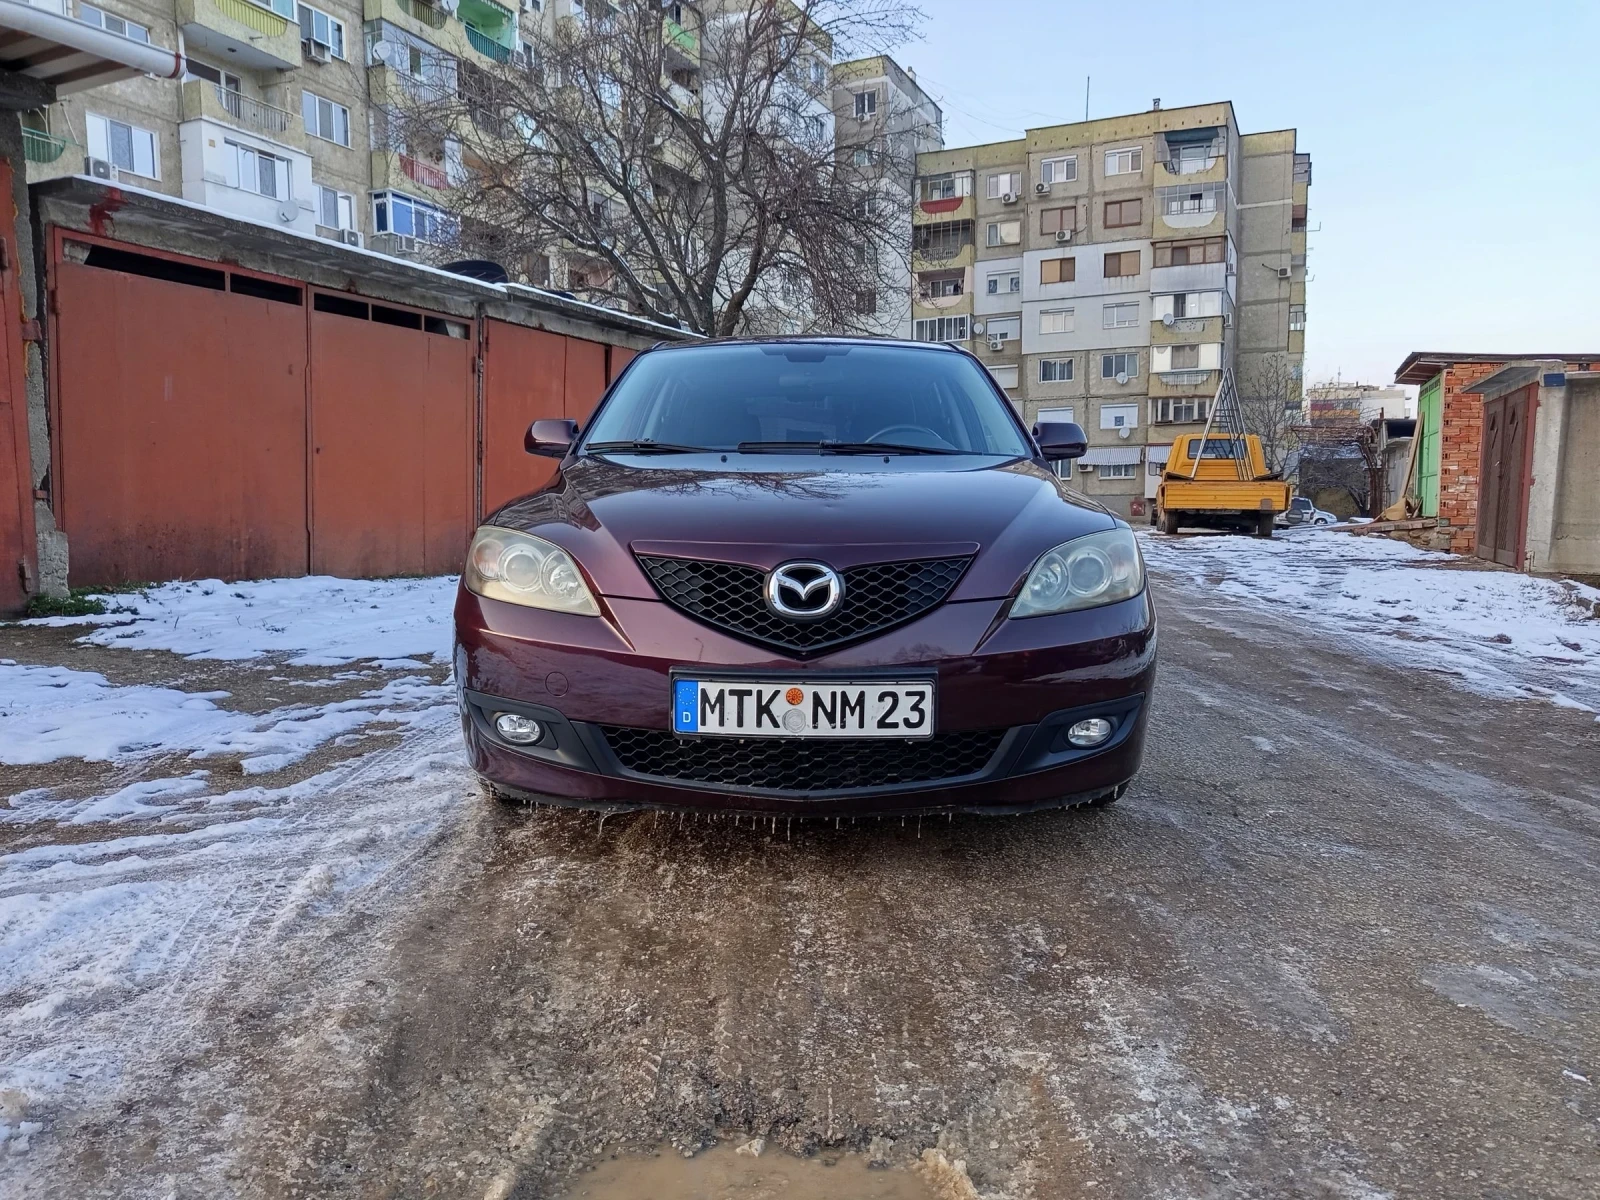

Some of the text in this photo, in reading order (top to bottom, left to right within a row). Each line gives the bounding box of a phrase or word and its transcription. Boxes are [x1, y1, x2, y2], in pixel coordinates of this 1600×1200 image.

[682, 711, 691, 723] D
[700, 688, 926, 729] MTK NM 23
